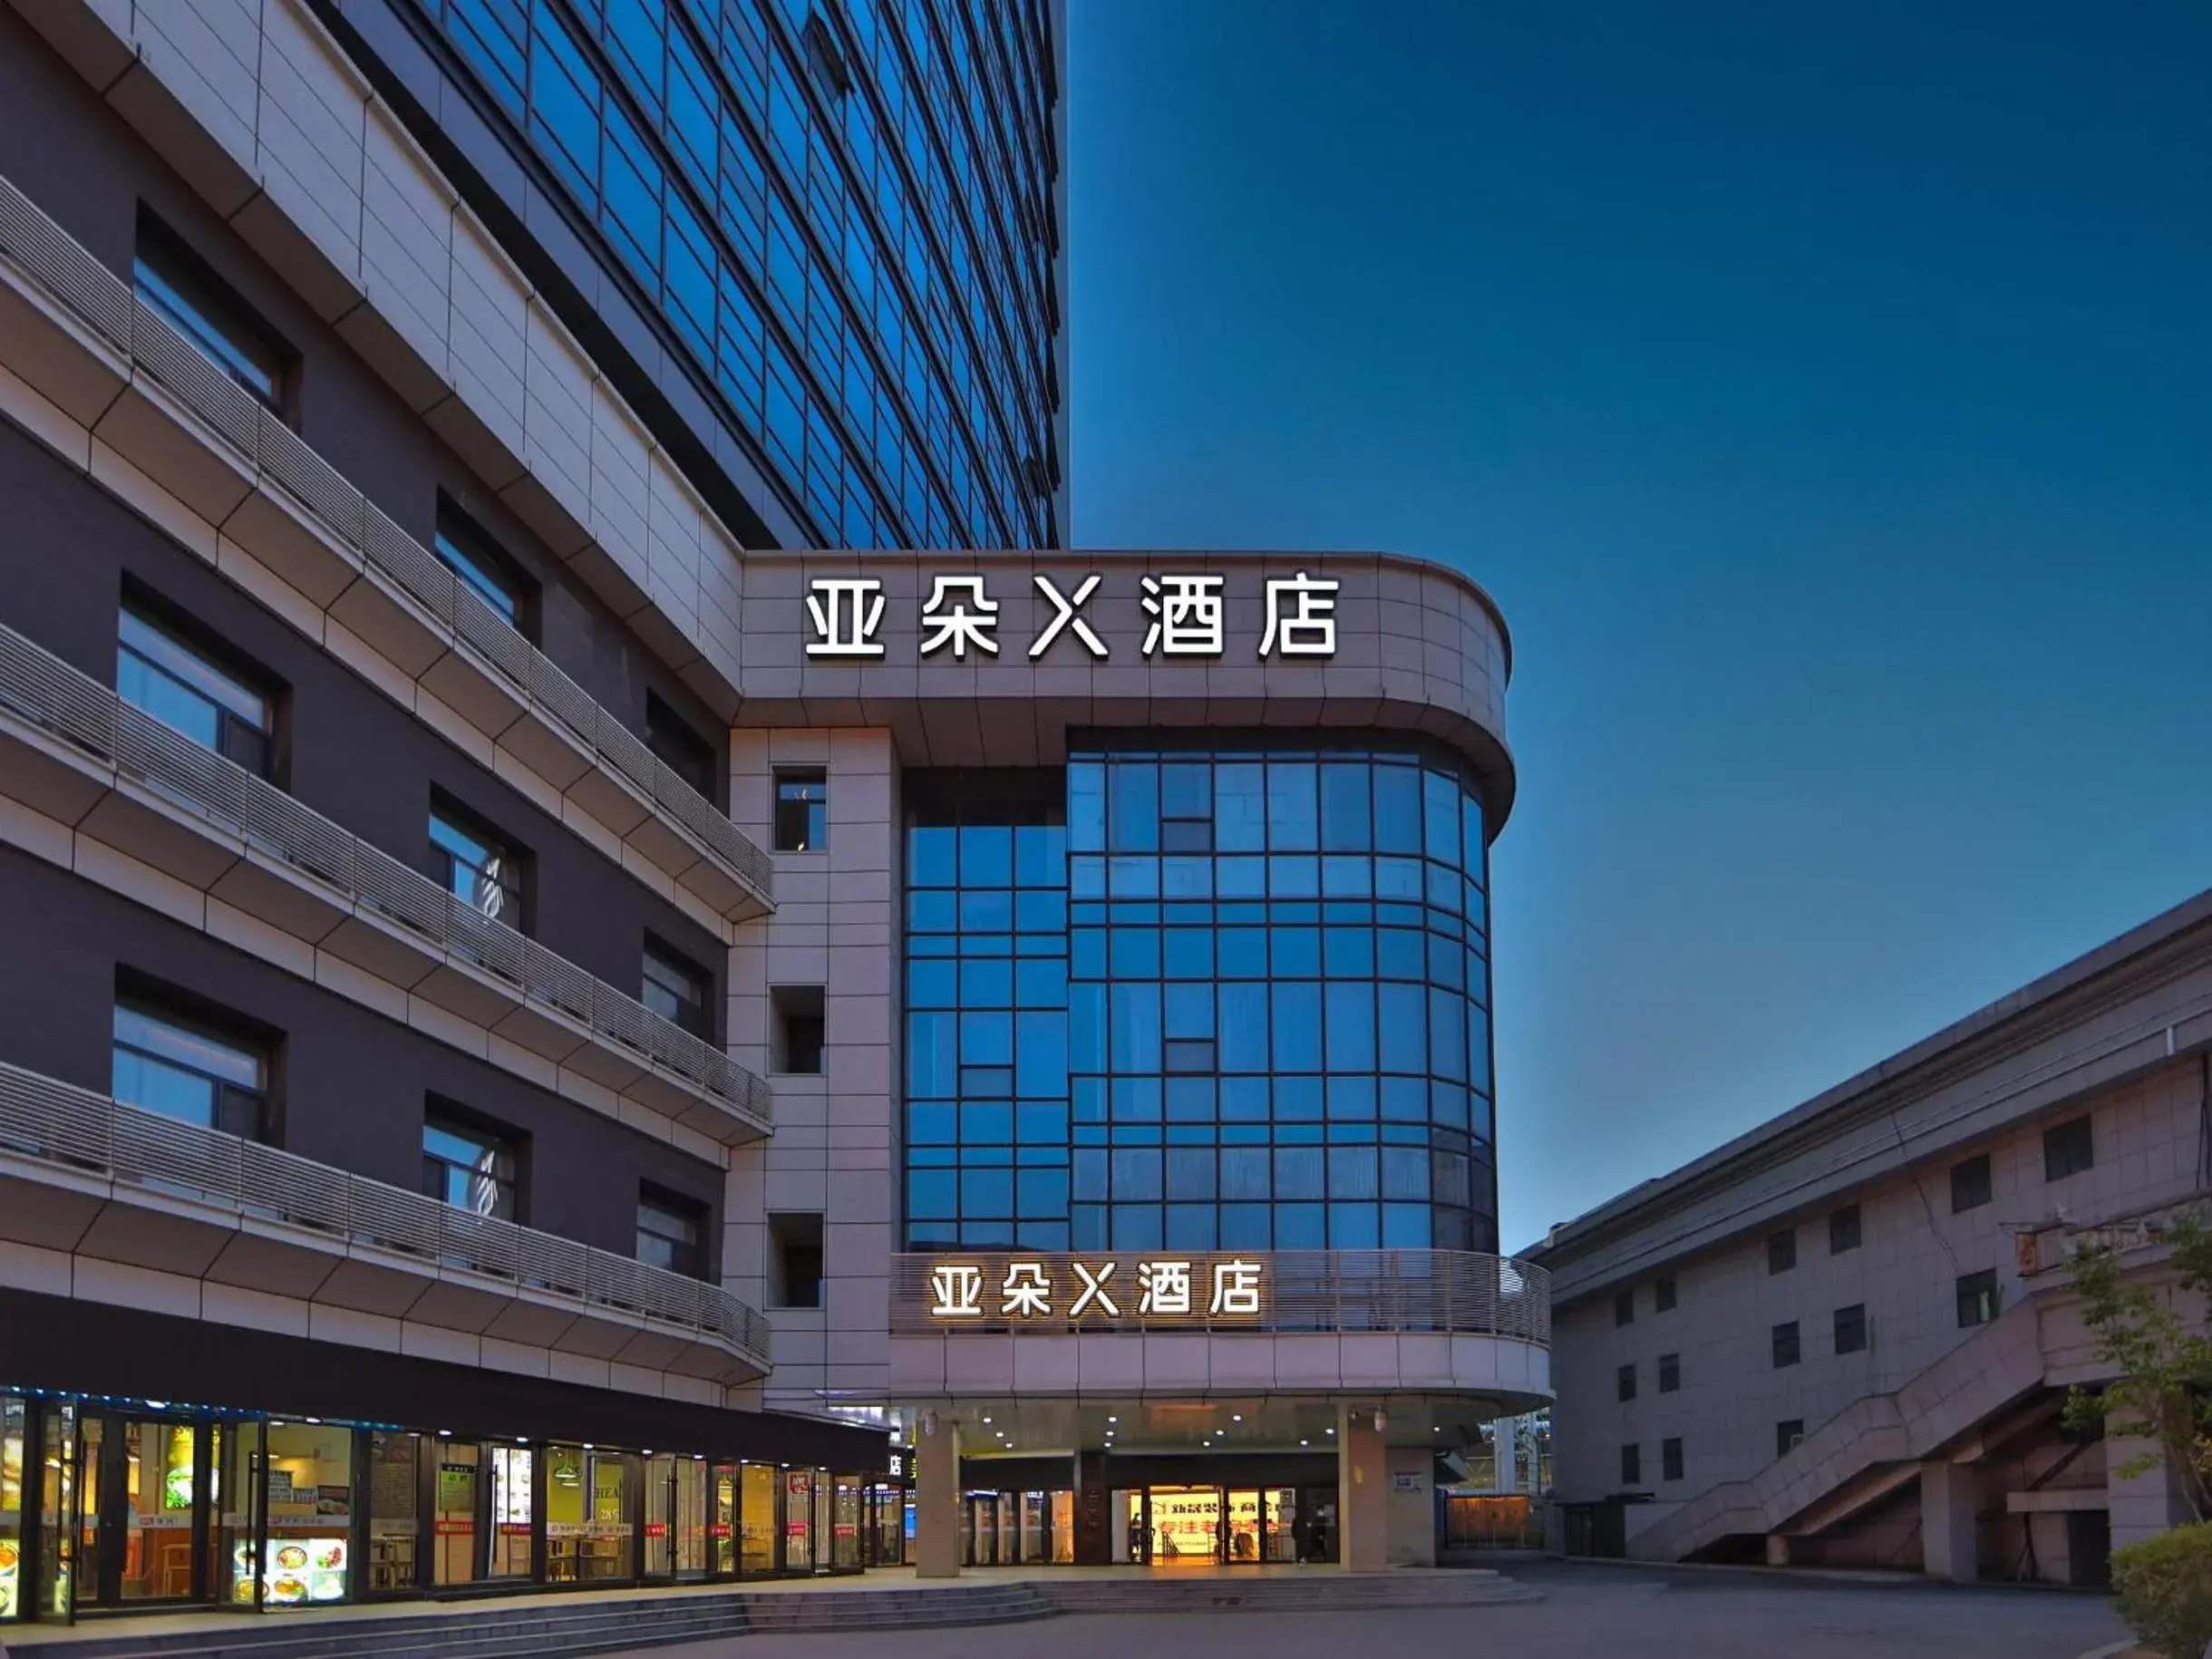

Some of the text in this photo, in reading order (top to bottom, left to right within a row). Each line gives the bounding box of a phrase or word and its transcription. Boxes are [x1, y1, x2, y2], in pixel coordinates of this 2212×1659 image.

[806, 572, 1339, 659] 亚朵X酒店
[930, 1259, 1262, 1316] 亚朵X酒店
